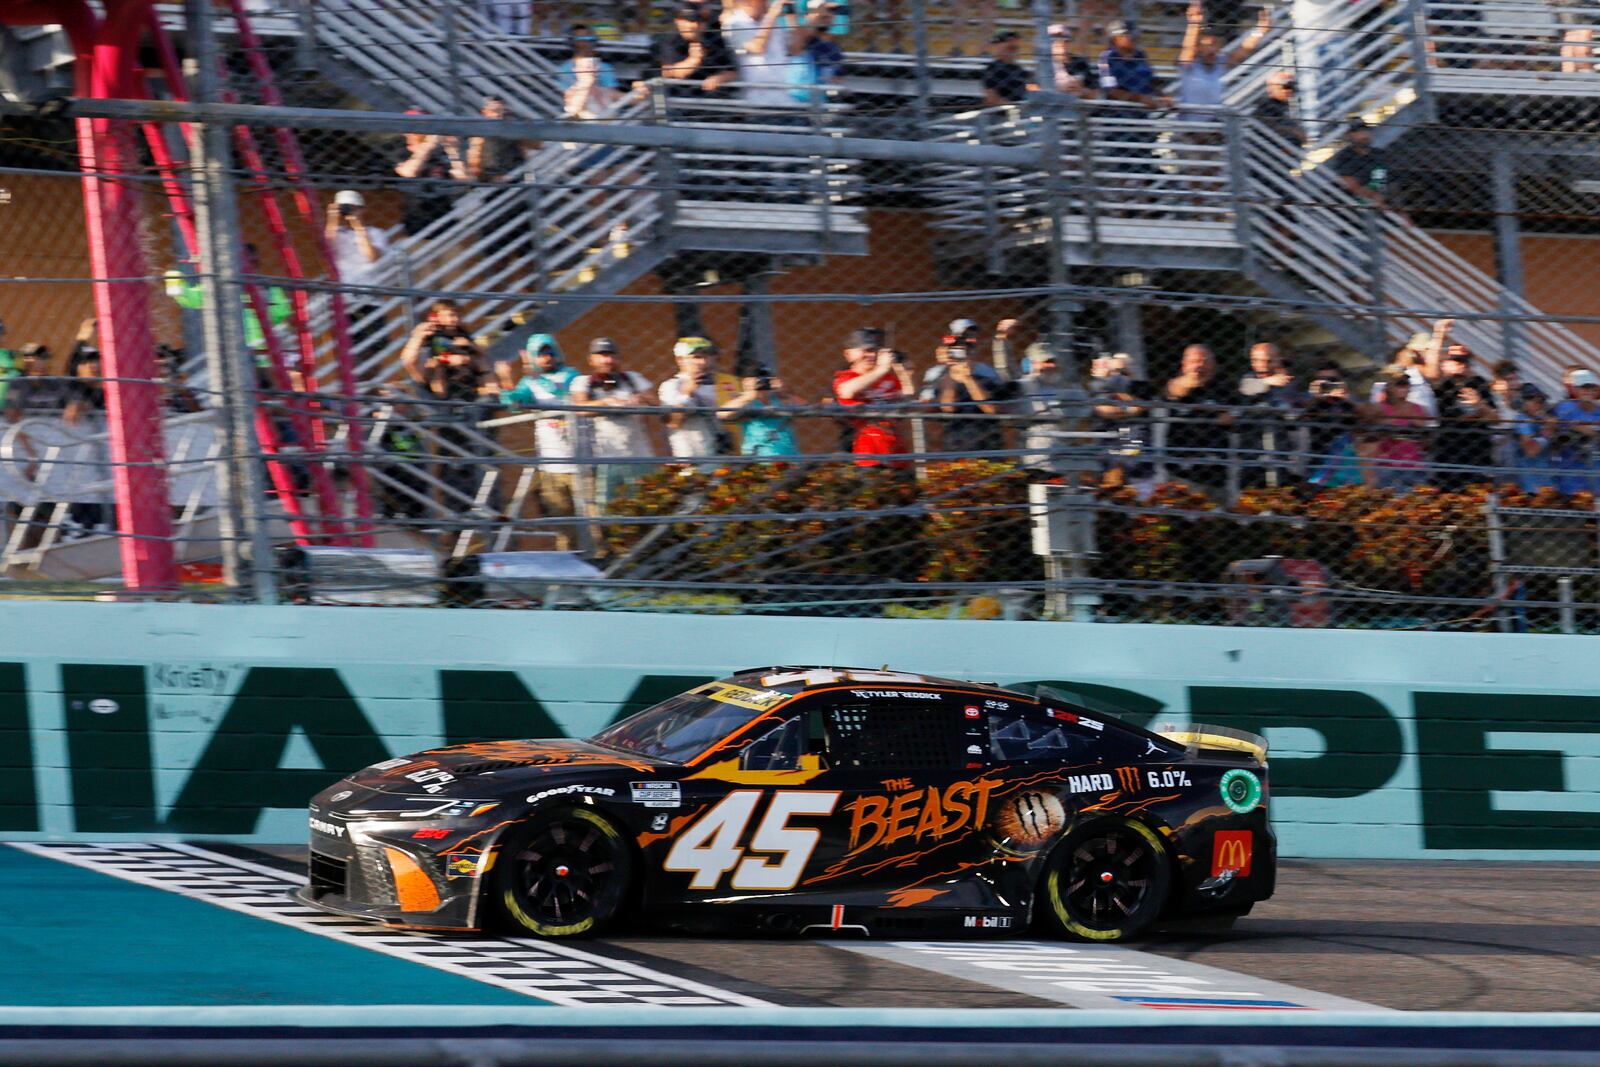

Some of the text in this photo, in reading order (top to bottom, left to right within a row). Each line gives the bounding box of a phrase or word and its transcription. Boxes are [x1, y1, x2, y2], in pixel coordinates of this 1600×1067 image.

[868, 690, 899, 698] TYLER
[900, 691, 942, 700] REDDICK
[881, 777, 915, 790] THE
[1068, 771, 1192, 793] HARD 6.0%
[526, 784, 616, 803] GOODYEAR
[841, 778, 1004, 857] BEAST
[663, 789, 843, 890] 45
[964, 916, 998, 928] Mobil
